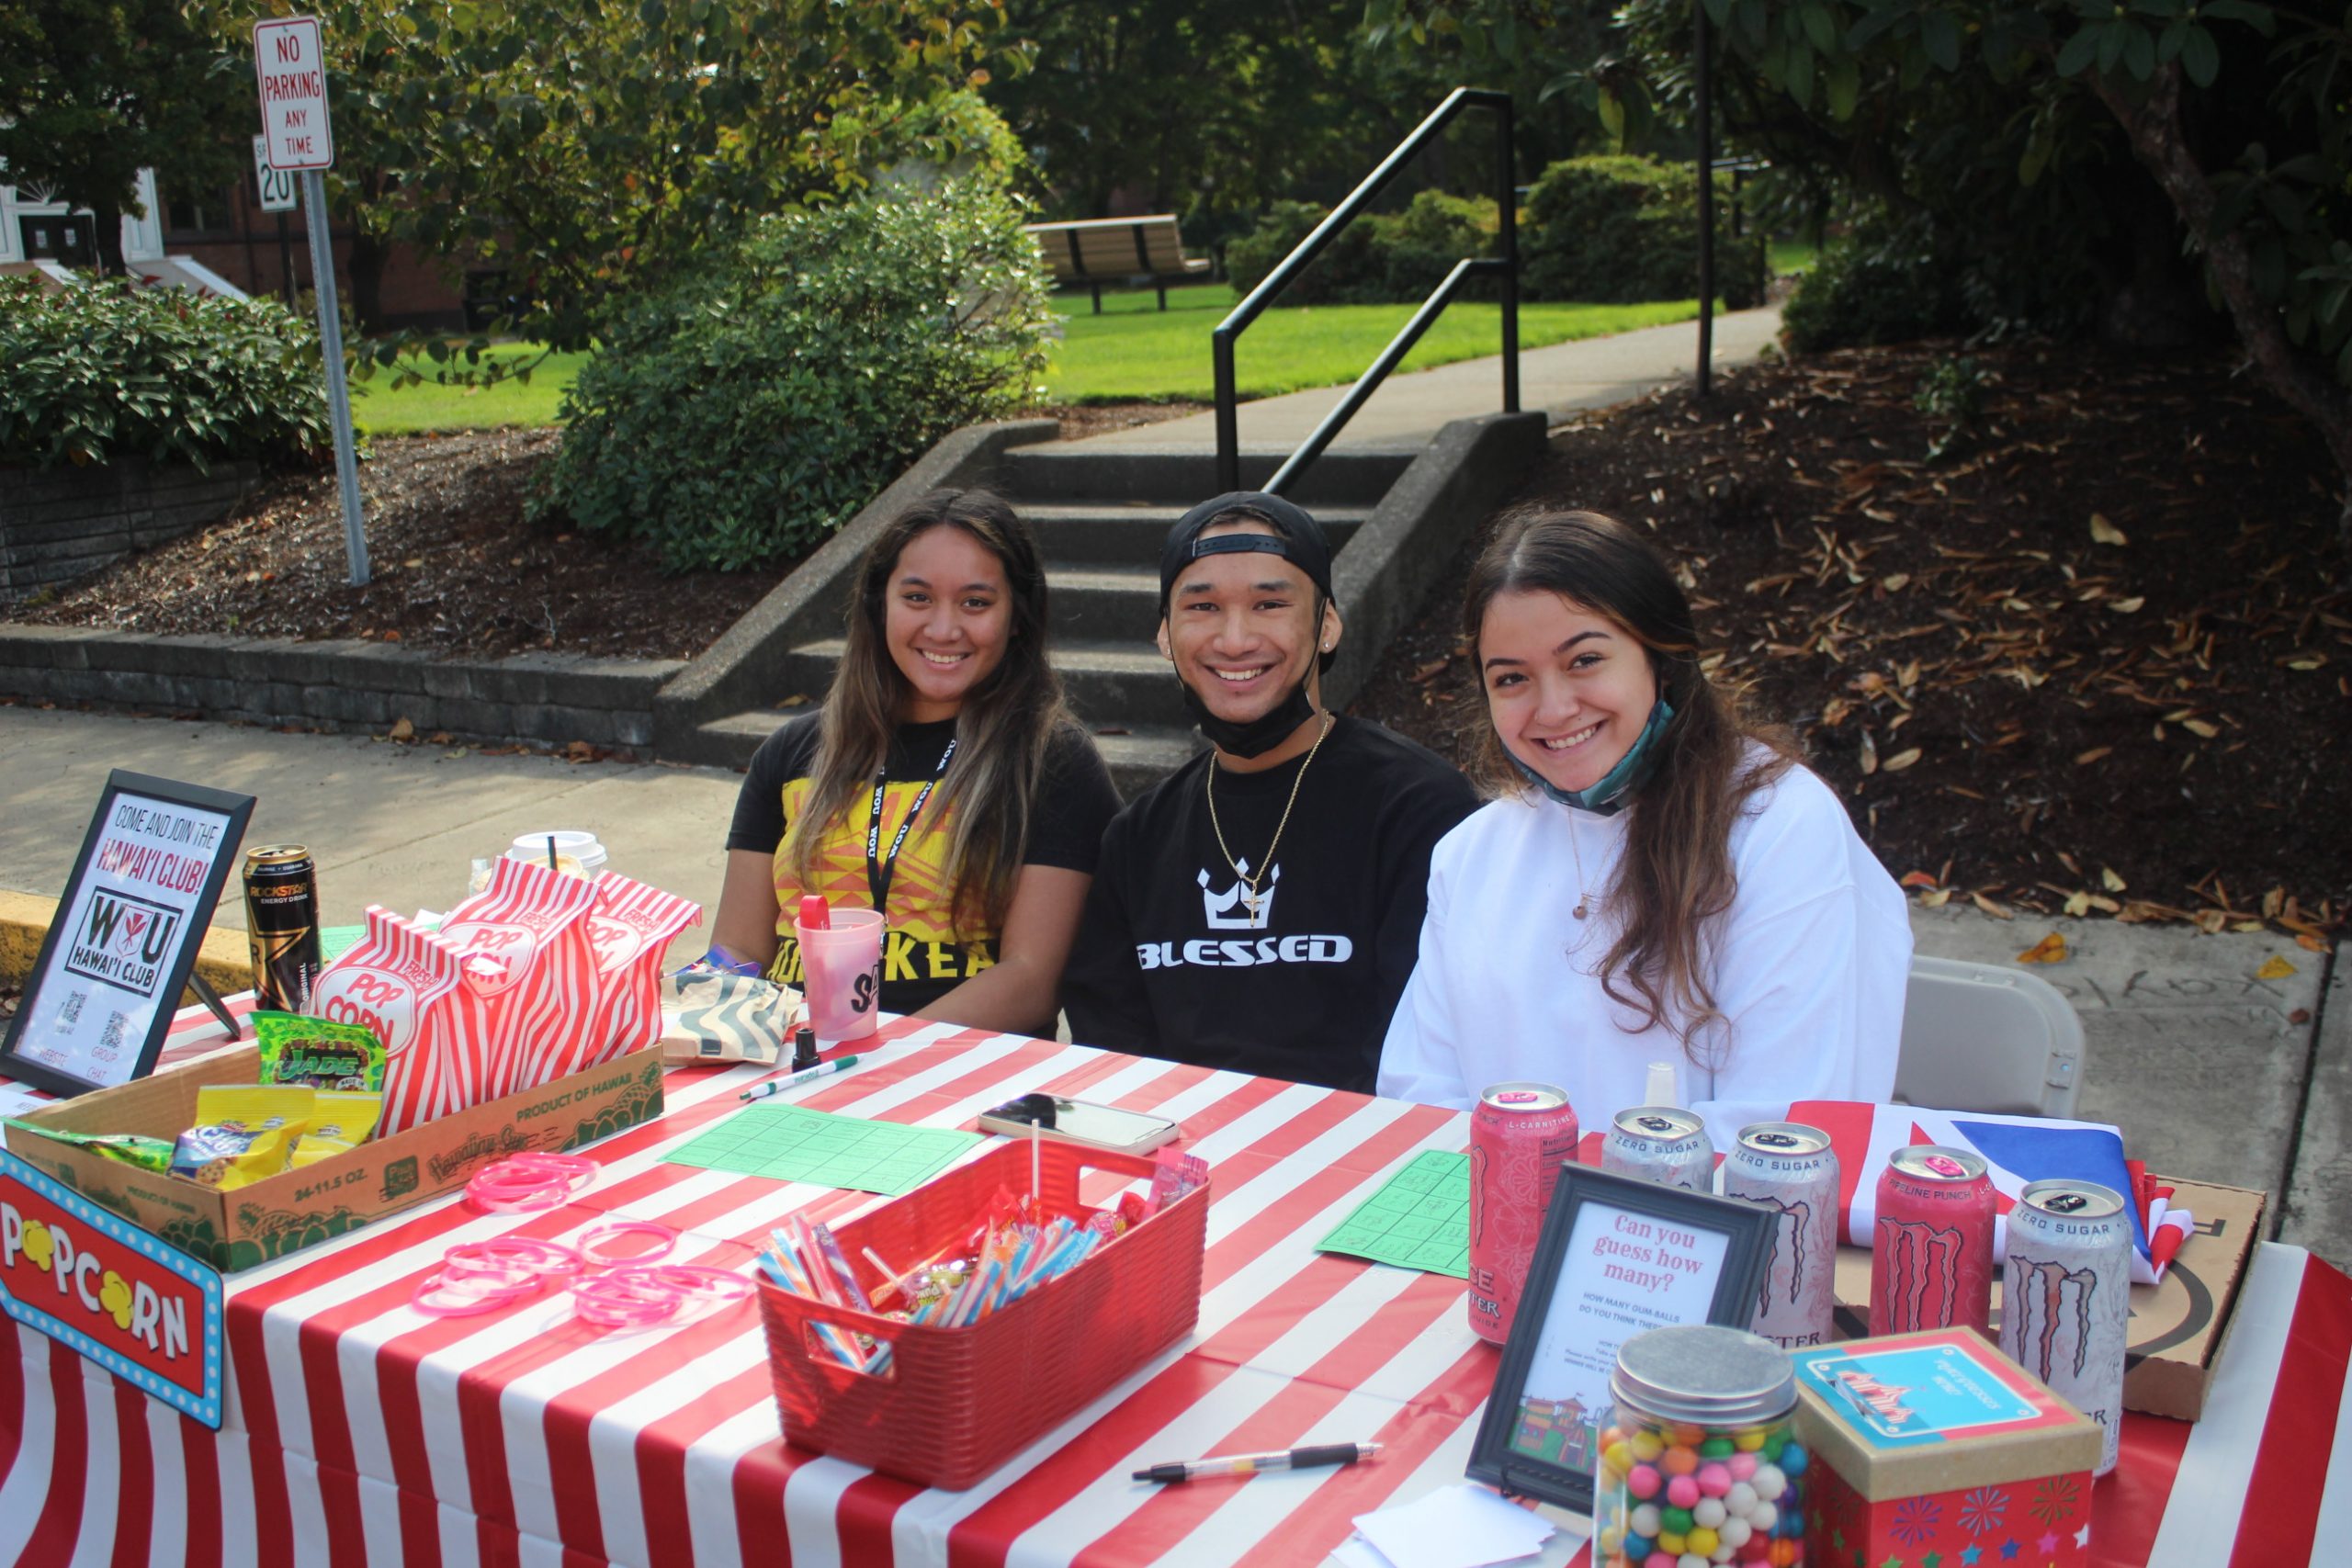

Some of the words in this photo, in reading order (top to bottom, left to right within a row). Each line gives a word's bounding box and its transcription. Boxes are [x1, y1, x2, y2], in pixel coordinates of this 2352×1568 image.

[277, 35, 300, 63] NO
[265, 71, 321, 102] PARKING
[286, 109, 307, 129] ANY
[286, 136, 313, 155] TIME
[260, 164, 289, 202] 20
[936, 739, 957, 772] WOU
[872, 785, 883, 815] WOU
[911, 781, 933, 813] WOU
[115, 804, 149, 833] COME
[143, 812, 172, 838] AND
[166, 817, 196, 844] JOIN
[193, 822, 219, 850] THE
[867, 825, 878, 858] WOU
[888, 824, 909, 860] WOU
[156, 852, 209, 896] CLUB!
[250, 883, 308, 898] ROCKSTAR
[260, 897, 289, 905] ENERGY
[288, 893, 308, 903] DRINK
[468, 928, 524, 952] POP
[1136, 934, 1353, 971] BLESSED
[121, 962, 155, 987] CLUB
[300, 962, 310, 1001] ORIGINAL
[404, 959, 440, 990] FRESH
[345, 972, 405, 1010] POP
[277, 1048, 359, 1081] JADE
[516, 1092, 571, 1122] PRODUCT
[573, 1087, 590, 1102] OF
[1509, 1114, 1570, 1130] L-CARNITINE
[1615, 1135, 1647, 1152] ZERO
[1655, 1140, 1700, 1155] SUGAR
[1735, 1150, 1764, 1168] ZERO
[1771, 1159, 1820, 1171] SUGAR
[1889, 1178, 1931, 1199] PIPELINE
[1933, 1189, 1972, 1201] PUNCH
[1614, 1214, 1652, 1239] Can
[1655, 1227, 1696, 1250] you
[2017, 1209, 2047, 1230] ZERO
[2055, 1222, 2110, 1235] SUGAR
[1592, 1236, 1653, 1264] guess
[1656, 1248, 1704, 1275] how
[1602, 1263, 1675, 1293] many?
[1579, 1303, 1592, 1314] DO
[1594, 1308, 1612, 1319] YOU
[1612, 1313, 1636, 1326] THINK
[1583, 1292, 1605, 1303] HOW
[1605, 1297, 1631, 1311] MANY
